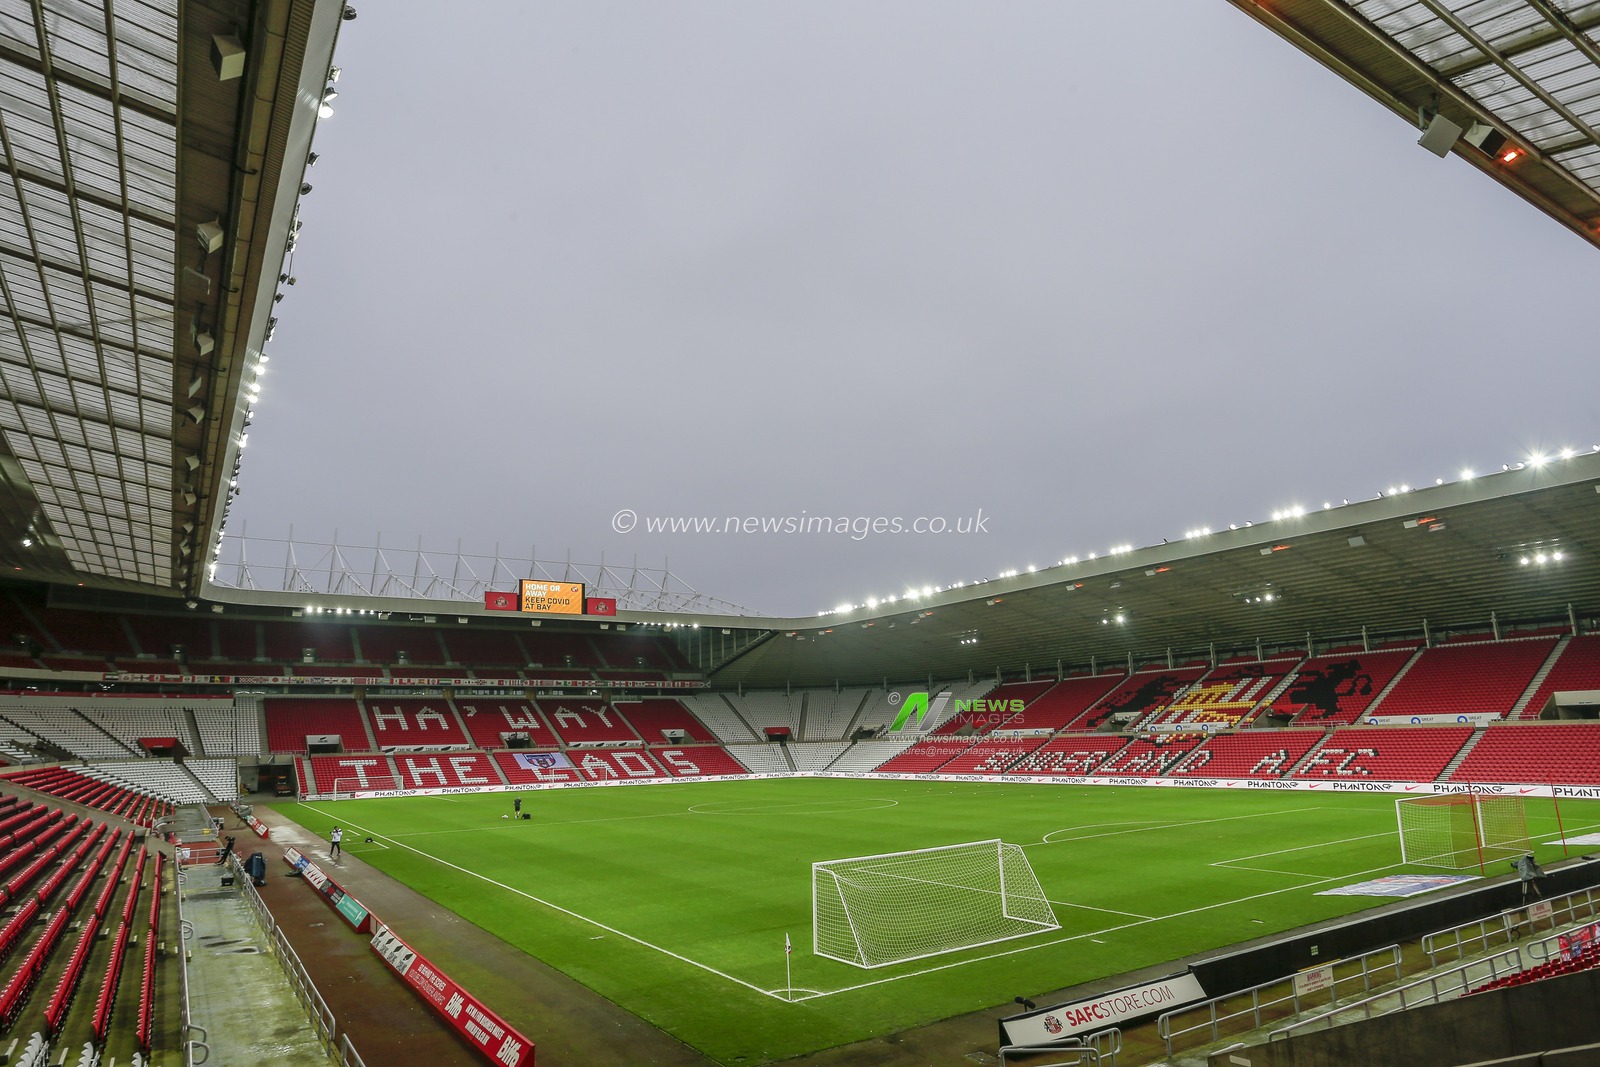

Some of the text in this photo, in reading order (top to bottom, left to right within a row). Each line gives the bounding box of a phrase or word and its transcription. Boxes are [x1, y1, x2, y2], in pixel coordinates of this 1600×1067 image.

[525, 583, 548, 591] HOME
[547, 597, 570, 605] COVID
[339, 756, 489, 788] THE
[1065, 985, 1176, 1027] SAFCSTORE.COM
